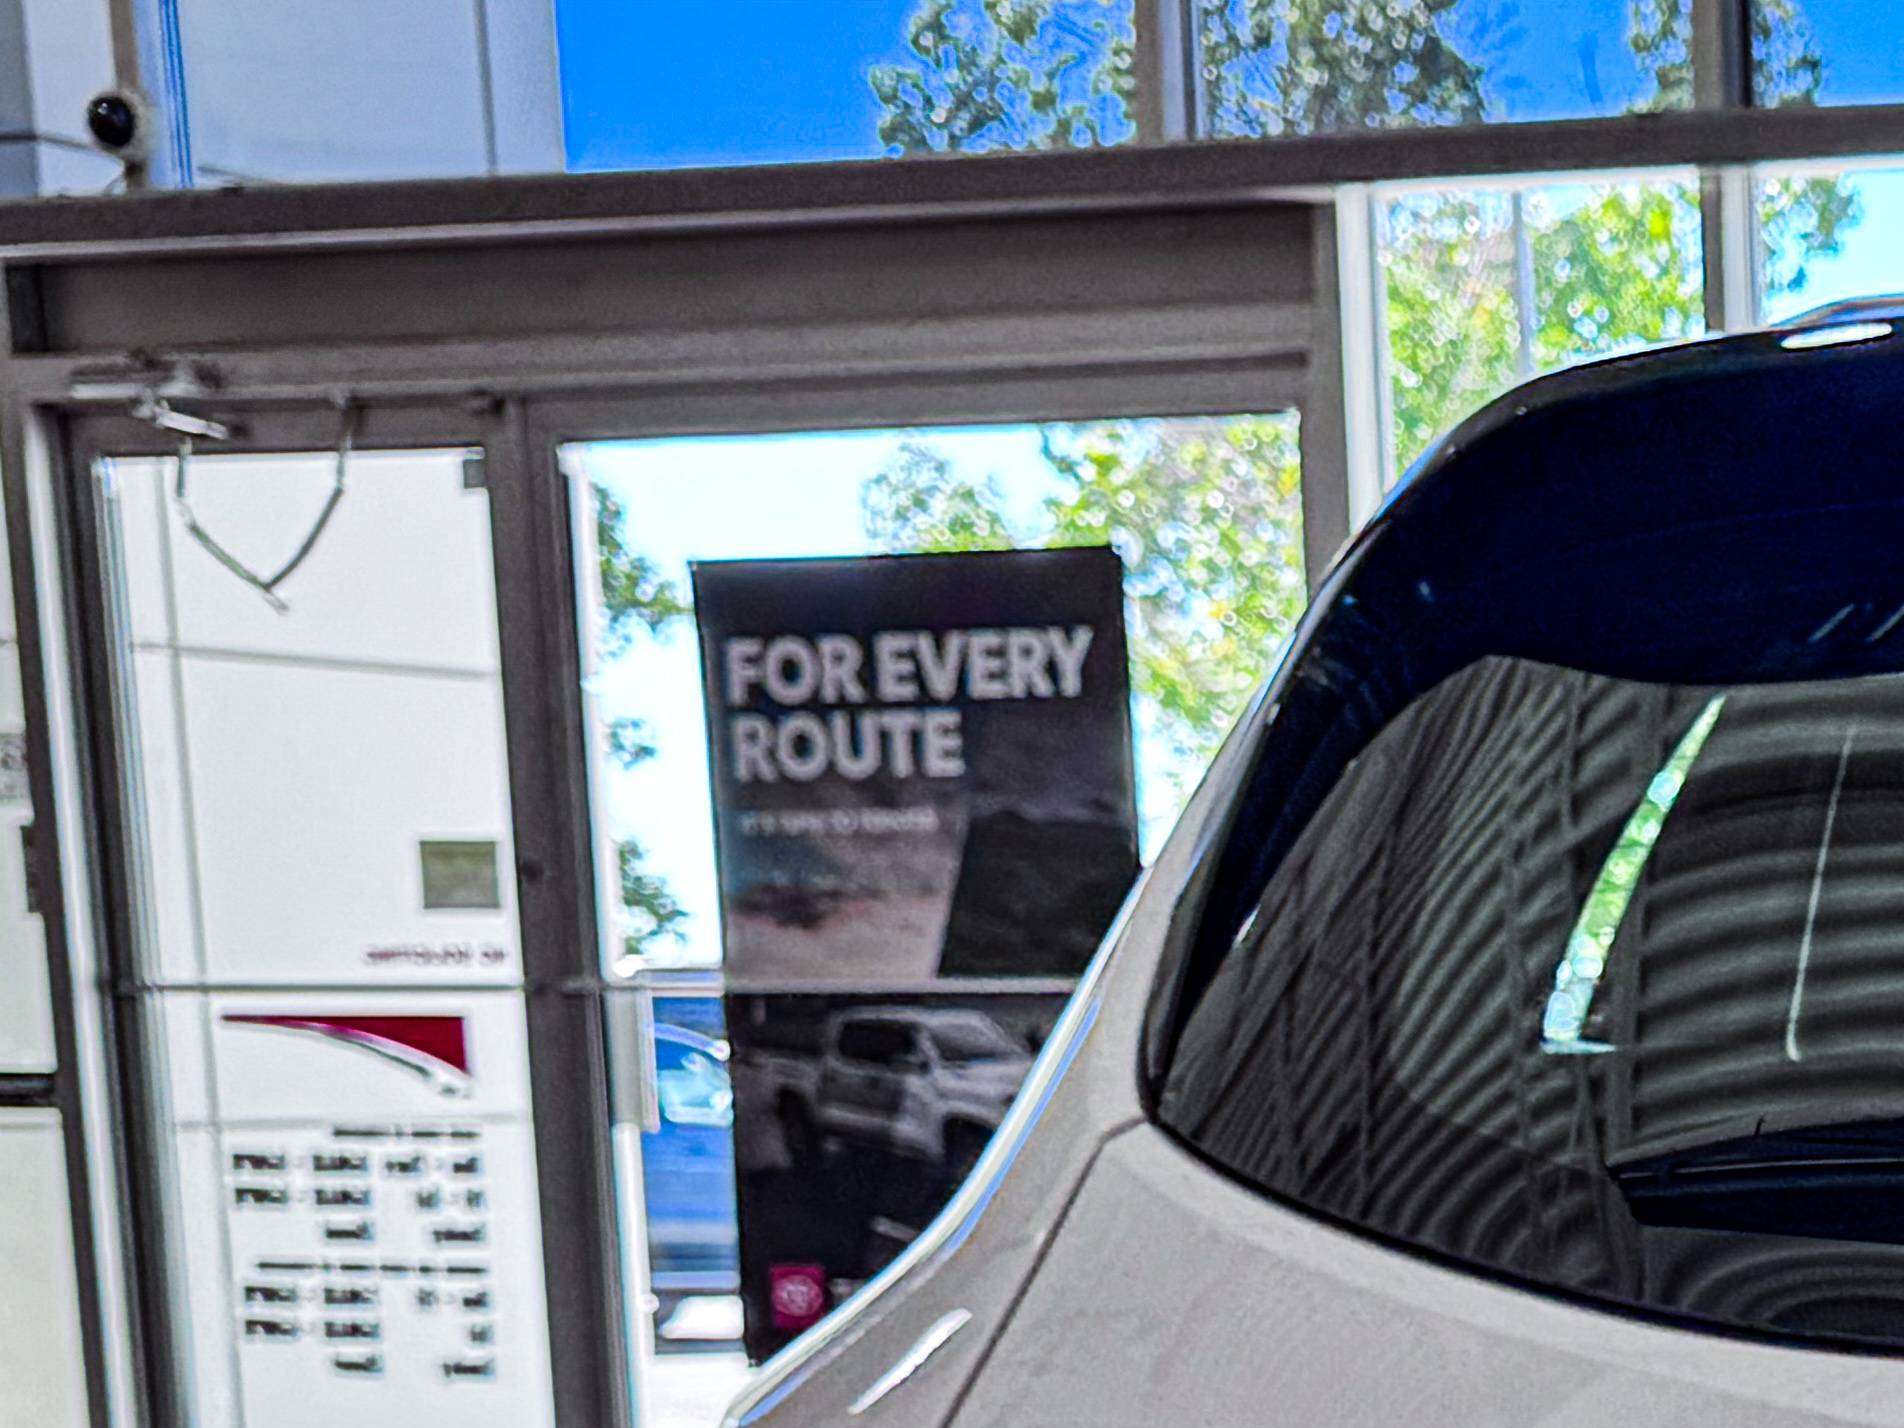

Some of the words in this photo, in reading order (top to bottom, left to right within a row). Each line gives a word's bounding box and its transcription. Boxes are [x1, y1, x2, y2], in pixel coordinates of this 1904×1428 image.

[725, 635, 866, 706] FOR
[873, 625, 1095, 704] EVERY
[731, 708, 967, 784] ROUTE
